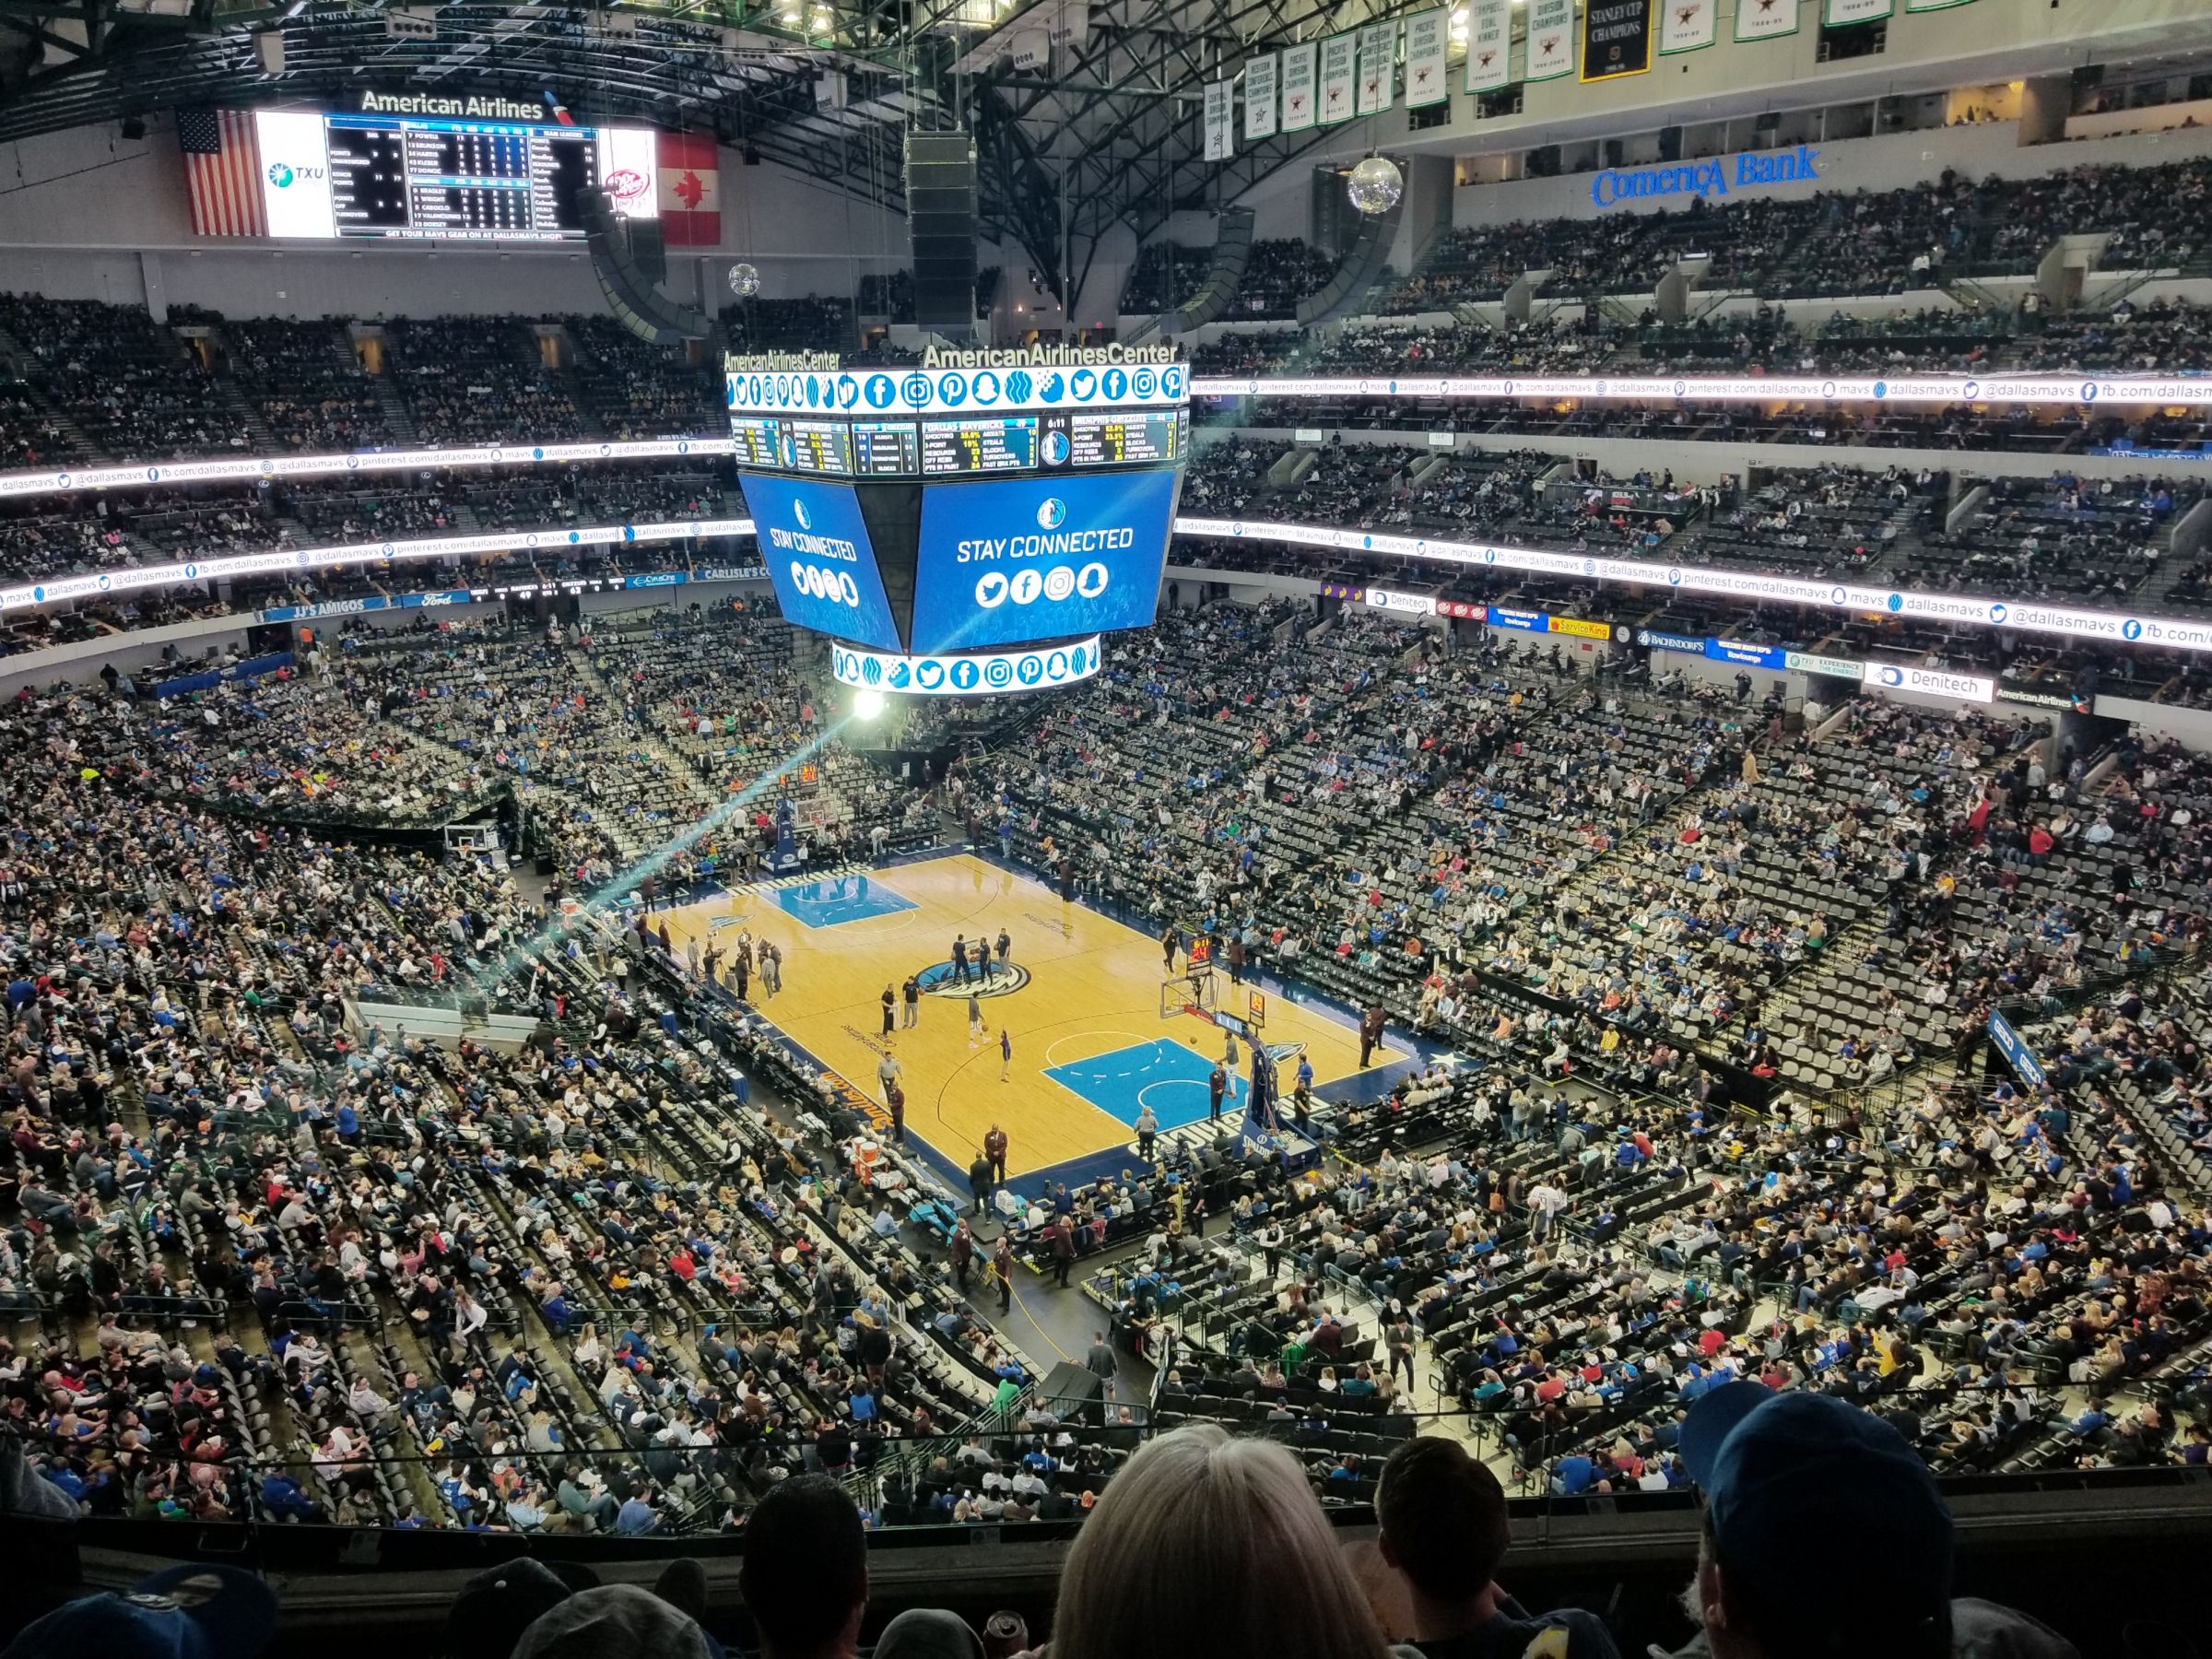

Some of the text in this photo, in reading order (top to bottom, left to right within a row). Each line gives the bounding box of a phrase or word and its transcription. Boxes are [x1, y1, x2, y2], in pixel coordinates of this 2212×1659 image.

[1533, 13, 1569, 30] CHAMPIONS
[1591, 2, 1643, 24] STANLEY CUP
[1592, 20, 1641, 42] CHAMPIONS
[1411, 44, 1440, 61] CHAMPIONS
[362, 90, 543, 119] American Airlines
[296, 168, 324, 178] TXU
[1735, 145, 1820, 186] Bank
[1840, 385, 1869, 395] mavs
[1890, 383, 1959, 395] dallasmavs
[1983, 383, 2075, 399] @dallasmavs
[927, 421, 1005, 432] DALLAS MAVERICKS
[1047, 419, 1065, 429] 6:11
[2, 477, 54, 491] dallasmavs
[76, 470, 144, 487] @dallasmavs
[277, 456, 345, 473] @dallasmavs
[546, 447, 597, 457] dallasmavs
[771, 528, 857, 561] STAY CONNECTED
[957, 527, 1134, 562] STAY CONNECTED
[646, 574, 676, 582] CyrusOne
[705, 568, 759, 580] CARLISLE'S
[6, 593, 32, 603] mavs
[47, 582, 97, 596] dallasmavs
[114, 570, 182, 587] @dallasmavs
[570, 586, 582, 594] 62
[421, 593, 452, 606] Ford
[1391, 594, 1428, 608] Denitech
[1599, 562, 1665, 580] @dallasmavs
[1684, 573, 1828, 598] pinterest.com/dallasmavs
[1850, 594, 1884, 606] mavs
[1907, 597, 1983, 618] dallasmavs
[2013, 606, 2115, 633] @dallasmavs
[293, 599, 364, 618] JJ'S AMIGOS
[1651, 635, 1705, 651] BACHENDORF'S
[1819, 659, 1859, 670] EXPERIENCE
[1912, 671, 1978, 693] Denitech
[1995, 689, 2072, 708] American Airlines
